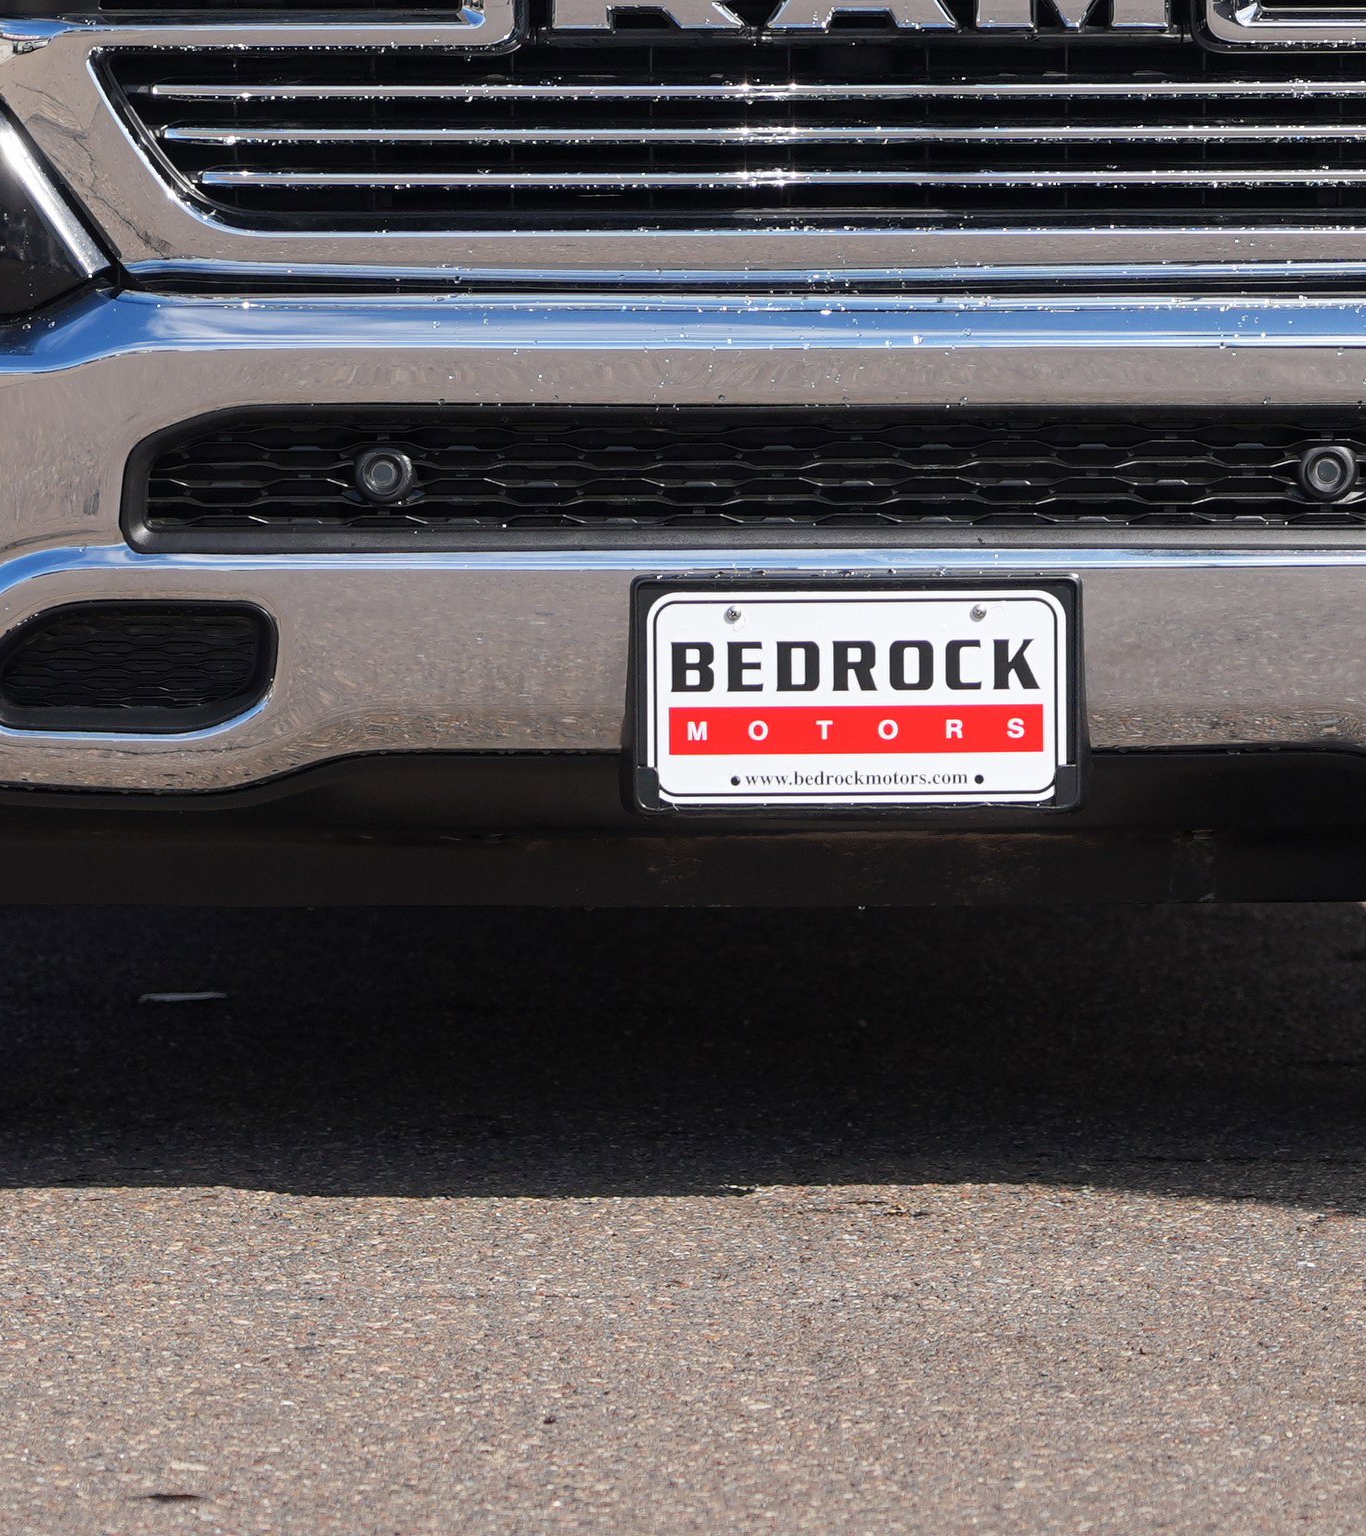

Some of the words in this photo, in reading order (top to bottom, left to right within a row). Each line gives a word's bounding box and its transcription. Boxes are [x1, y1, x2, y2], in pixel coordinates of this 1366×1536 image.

[670, 638, 1041, 693] BEDROCK
[686, 717, 1026, 742] MOTORS
[745, 770, 968, 786] www.bedrockmotors.com
